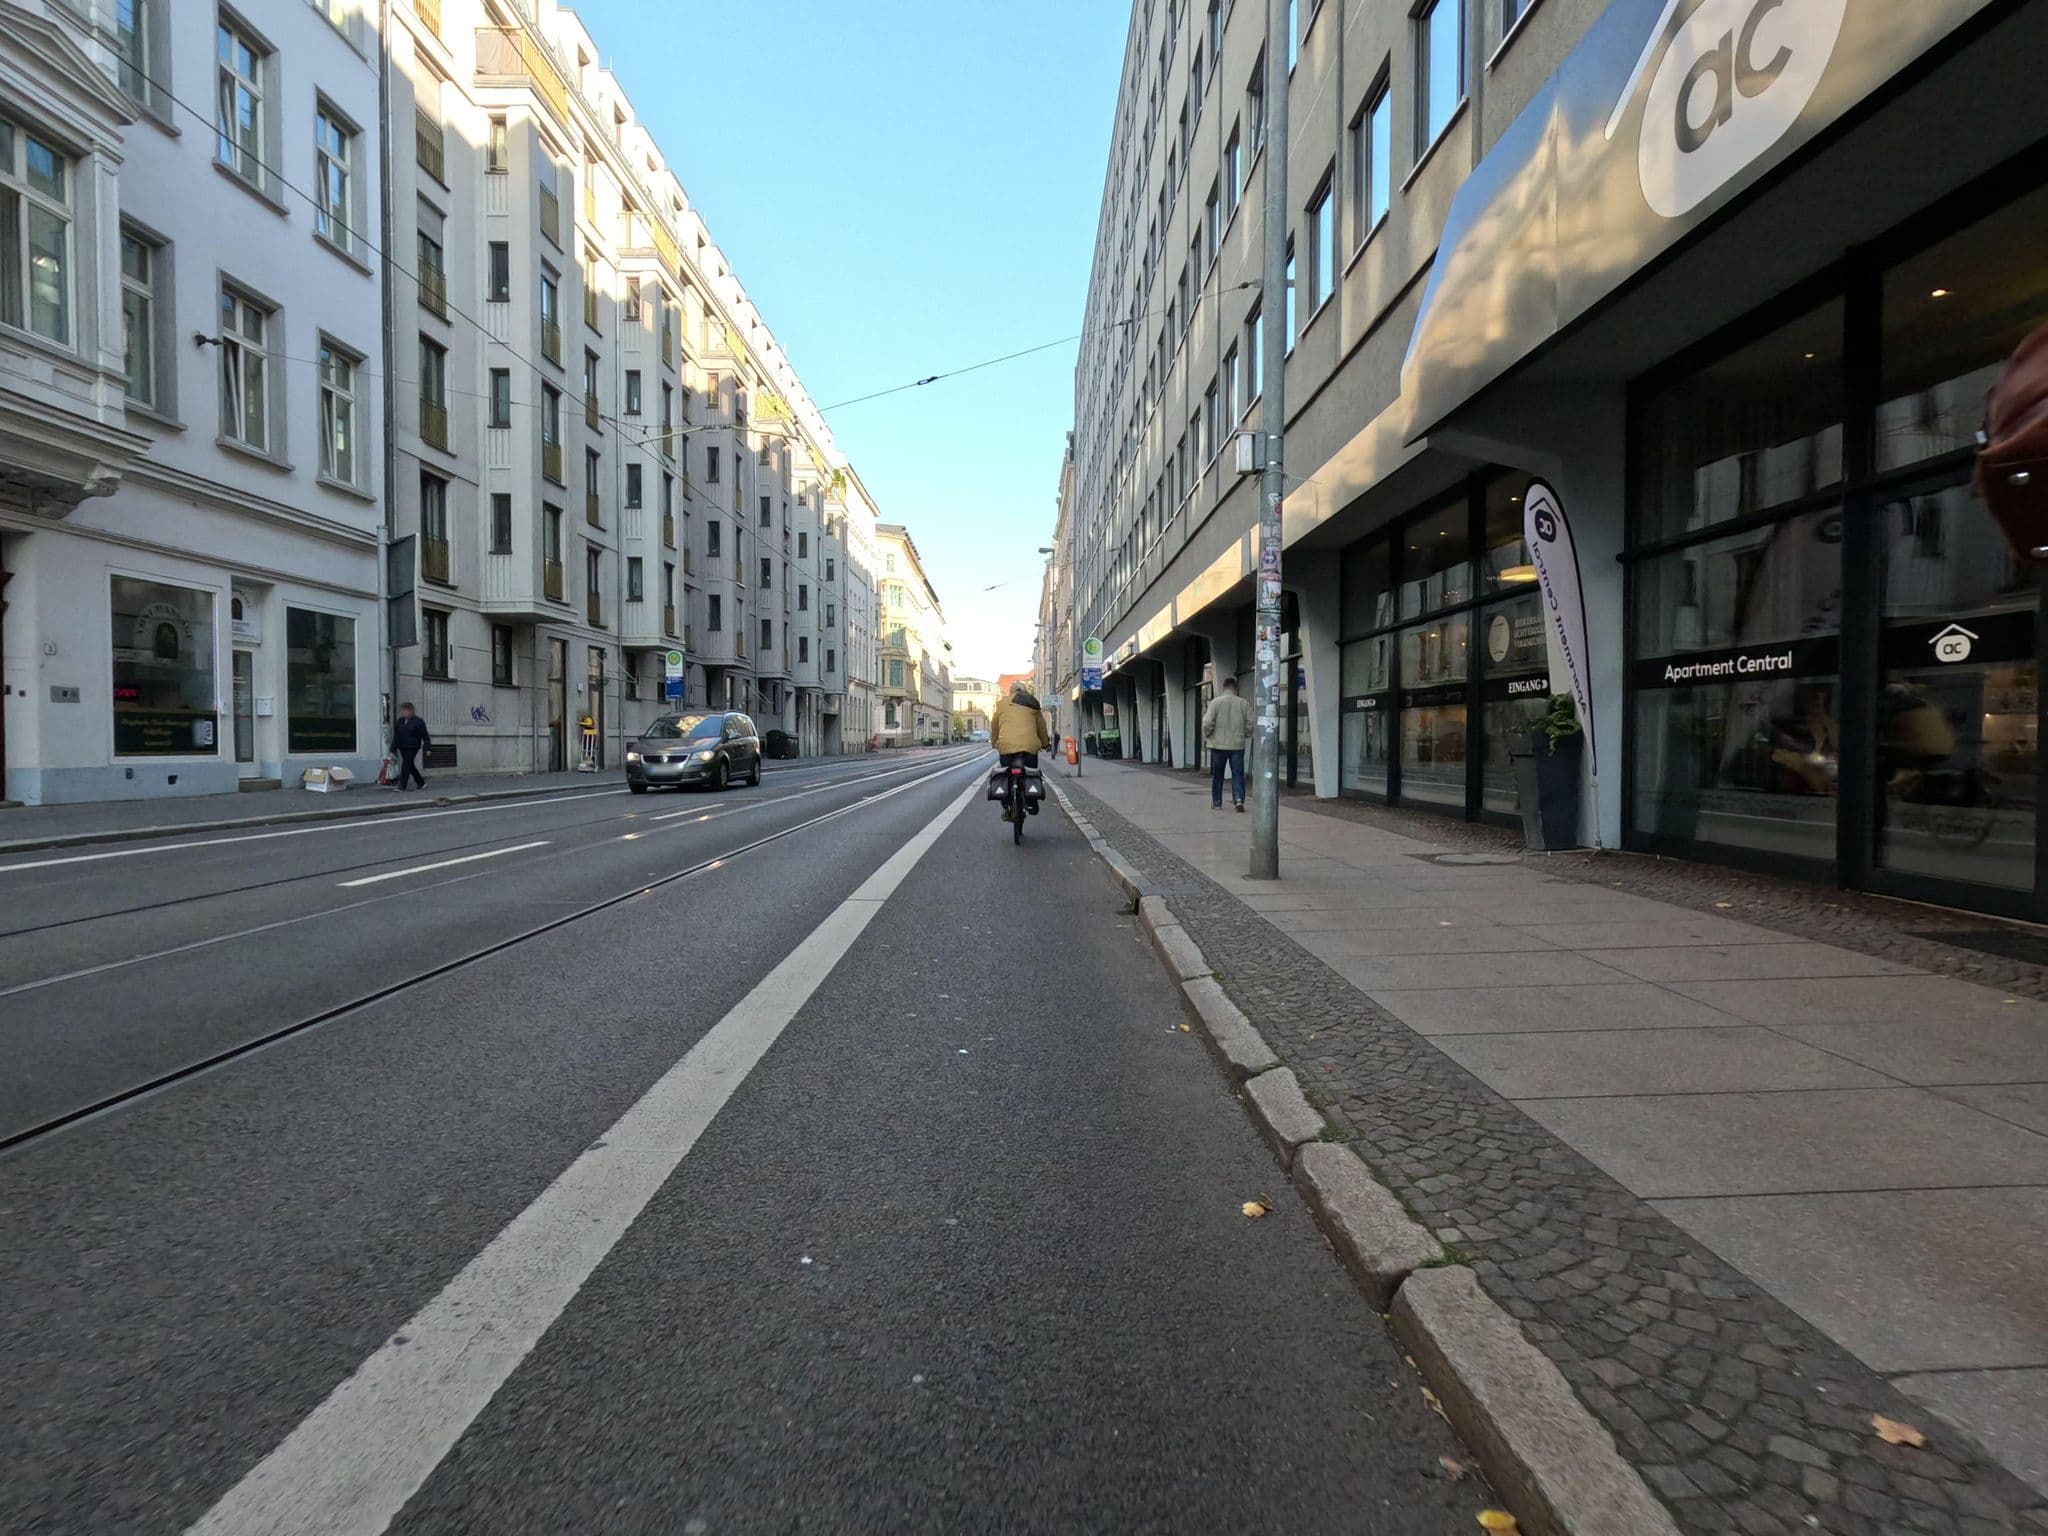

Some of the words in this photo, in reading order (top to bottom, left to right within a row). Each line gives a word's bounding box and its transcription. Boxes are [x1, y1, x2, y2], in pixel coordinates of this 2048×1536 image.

[1674, 0, 1793, 154] ac
[1943, 642, 1962, 655] ac
[1664, 659, 1734, 683] Apartment
[1737, 650, 1792, 673] Central
[1508, 679, 1541, 694] EINGANG
